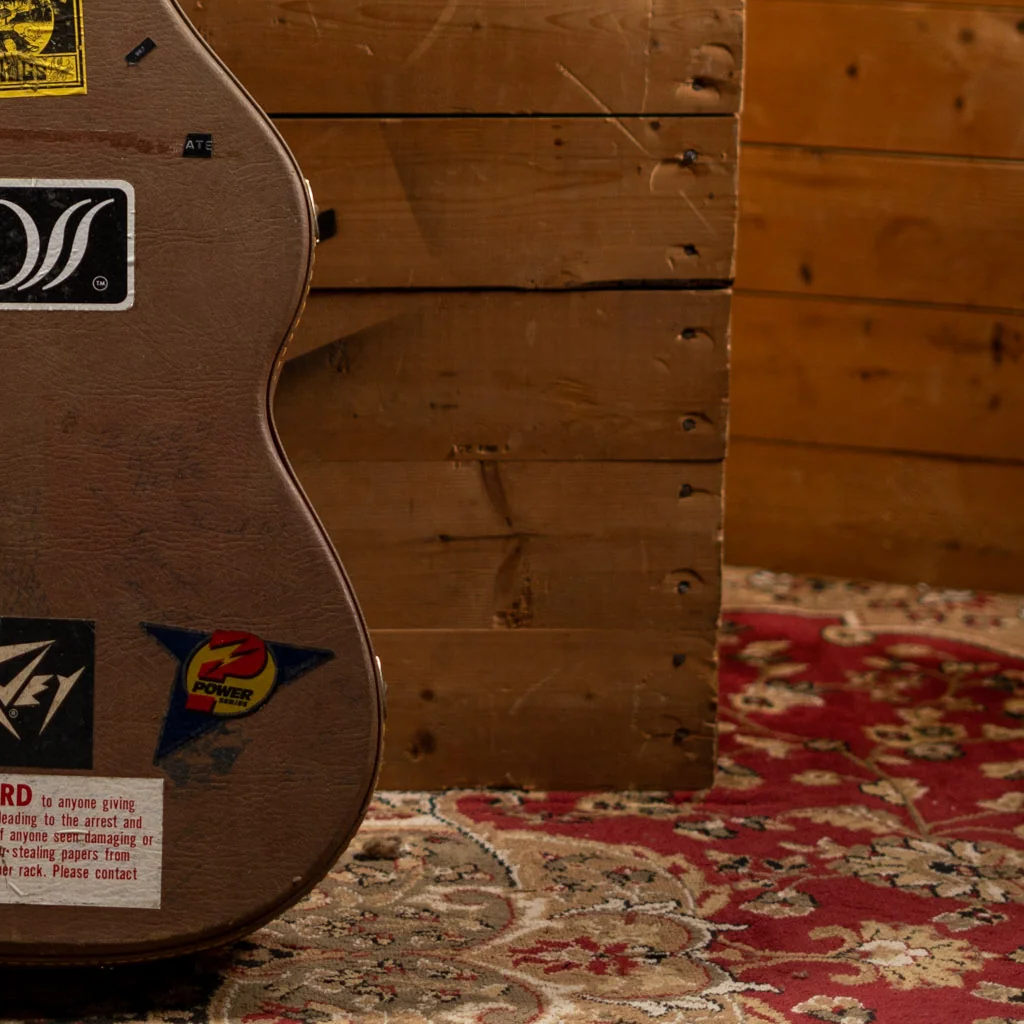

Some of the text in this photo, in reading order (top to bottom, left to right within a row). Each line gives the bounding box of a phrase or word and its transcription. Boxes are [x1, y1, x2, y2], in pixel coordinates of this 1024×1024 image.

[192, 681, 254, 701] POWER
[42, 795, 52, 808] to
[58, 798, 96, 811] anyone
[102, 796, 135, 813] giving
[44, 813, 55, 826] to
[62, 813, 79, 827] the
[85, 815, 118, 828] arrest
[123, 816, 142, 829] and
[9, 830, 48, 844] anyone
[54, 831, 79, 843] seen
[84, 831, 137, 848] damaging
[142, 835, 154, 846] or
[12, 845, 55, 862] stealing
[61, 848, 98, 862] papers
[105, 847, 130, 861] from
[18, 863, 47, 878] rack.
[52, 864, 89, 879] Please
[95, 867, 138, 880] contact
